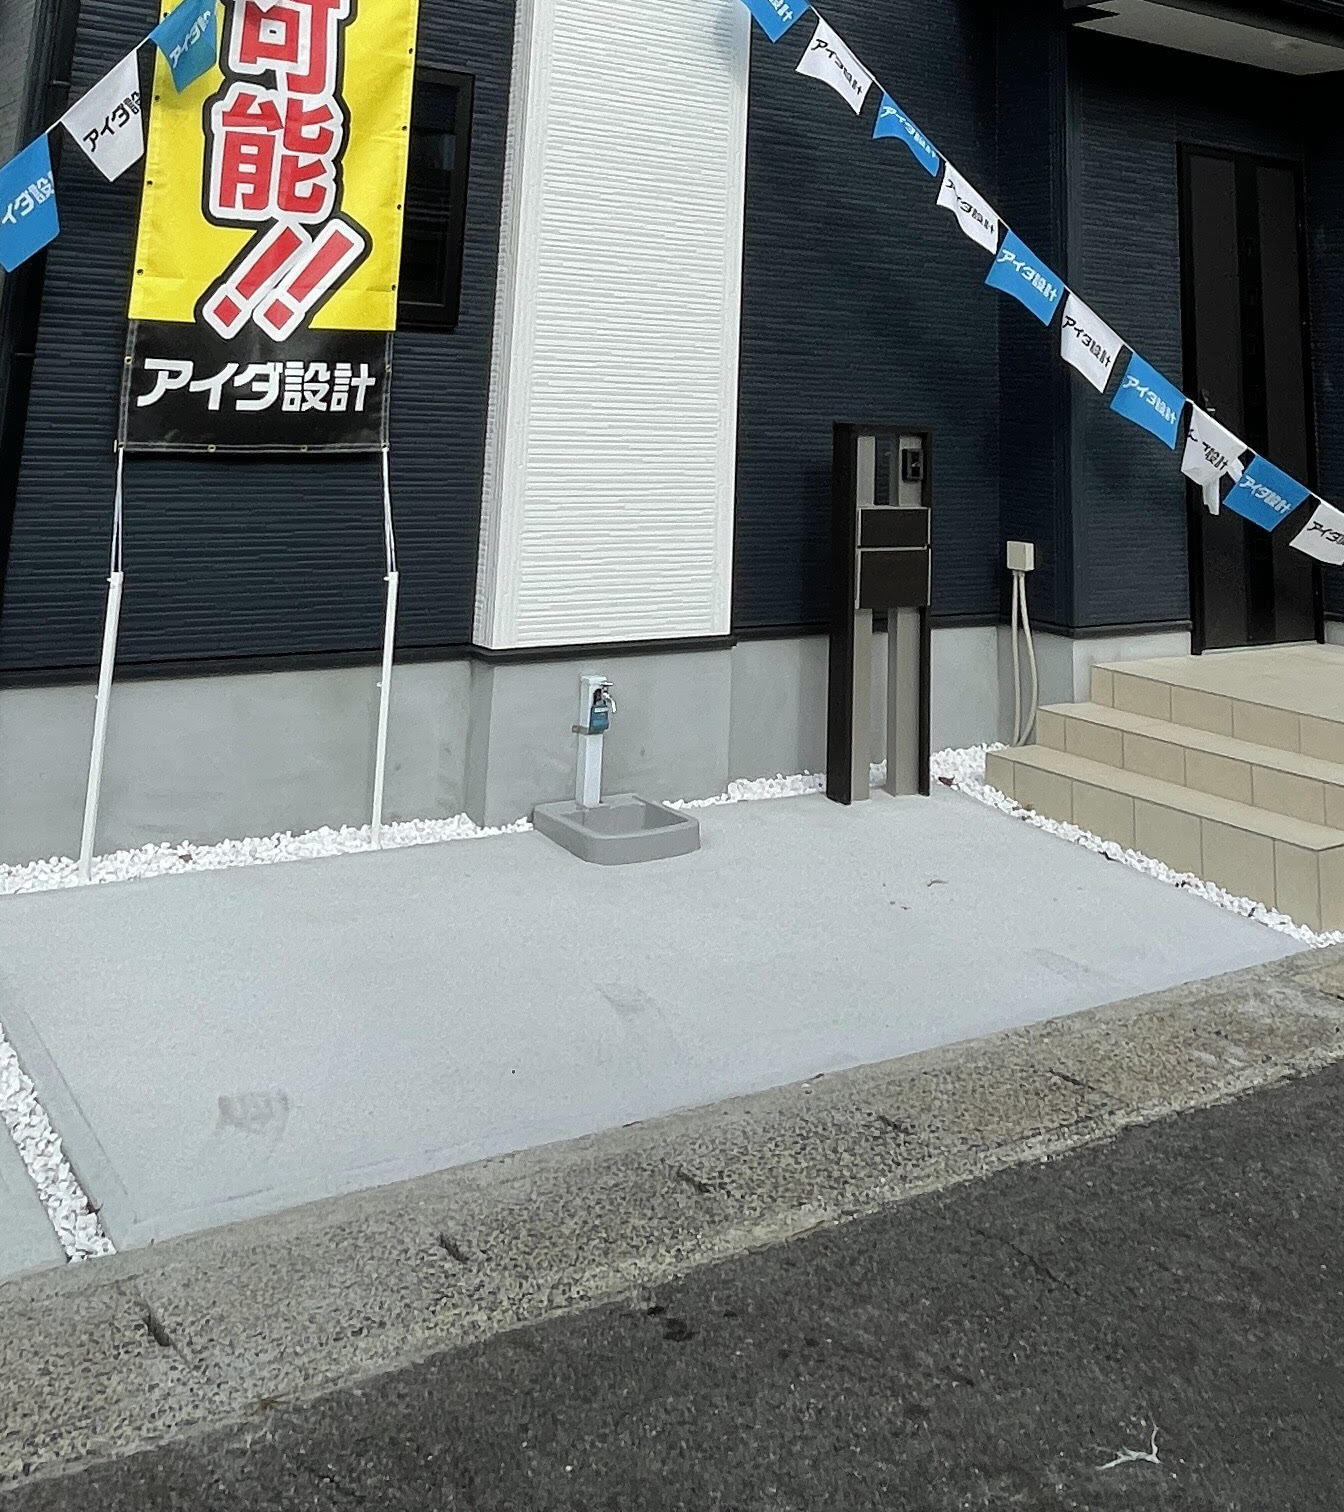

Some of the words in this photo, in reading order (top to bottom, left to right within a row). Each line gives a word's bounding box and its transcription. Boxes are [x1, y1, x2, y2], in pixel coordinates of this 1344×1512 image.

[996, 248, 1058, 303] アイダ設計
[1061, 315, 1112, 369] アイダ設計
[136, 356, 377, 414] アイダ設計
[1122, 374, 1178, 426] アイダ設計
